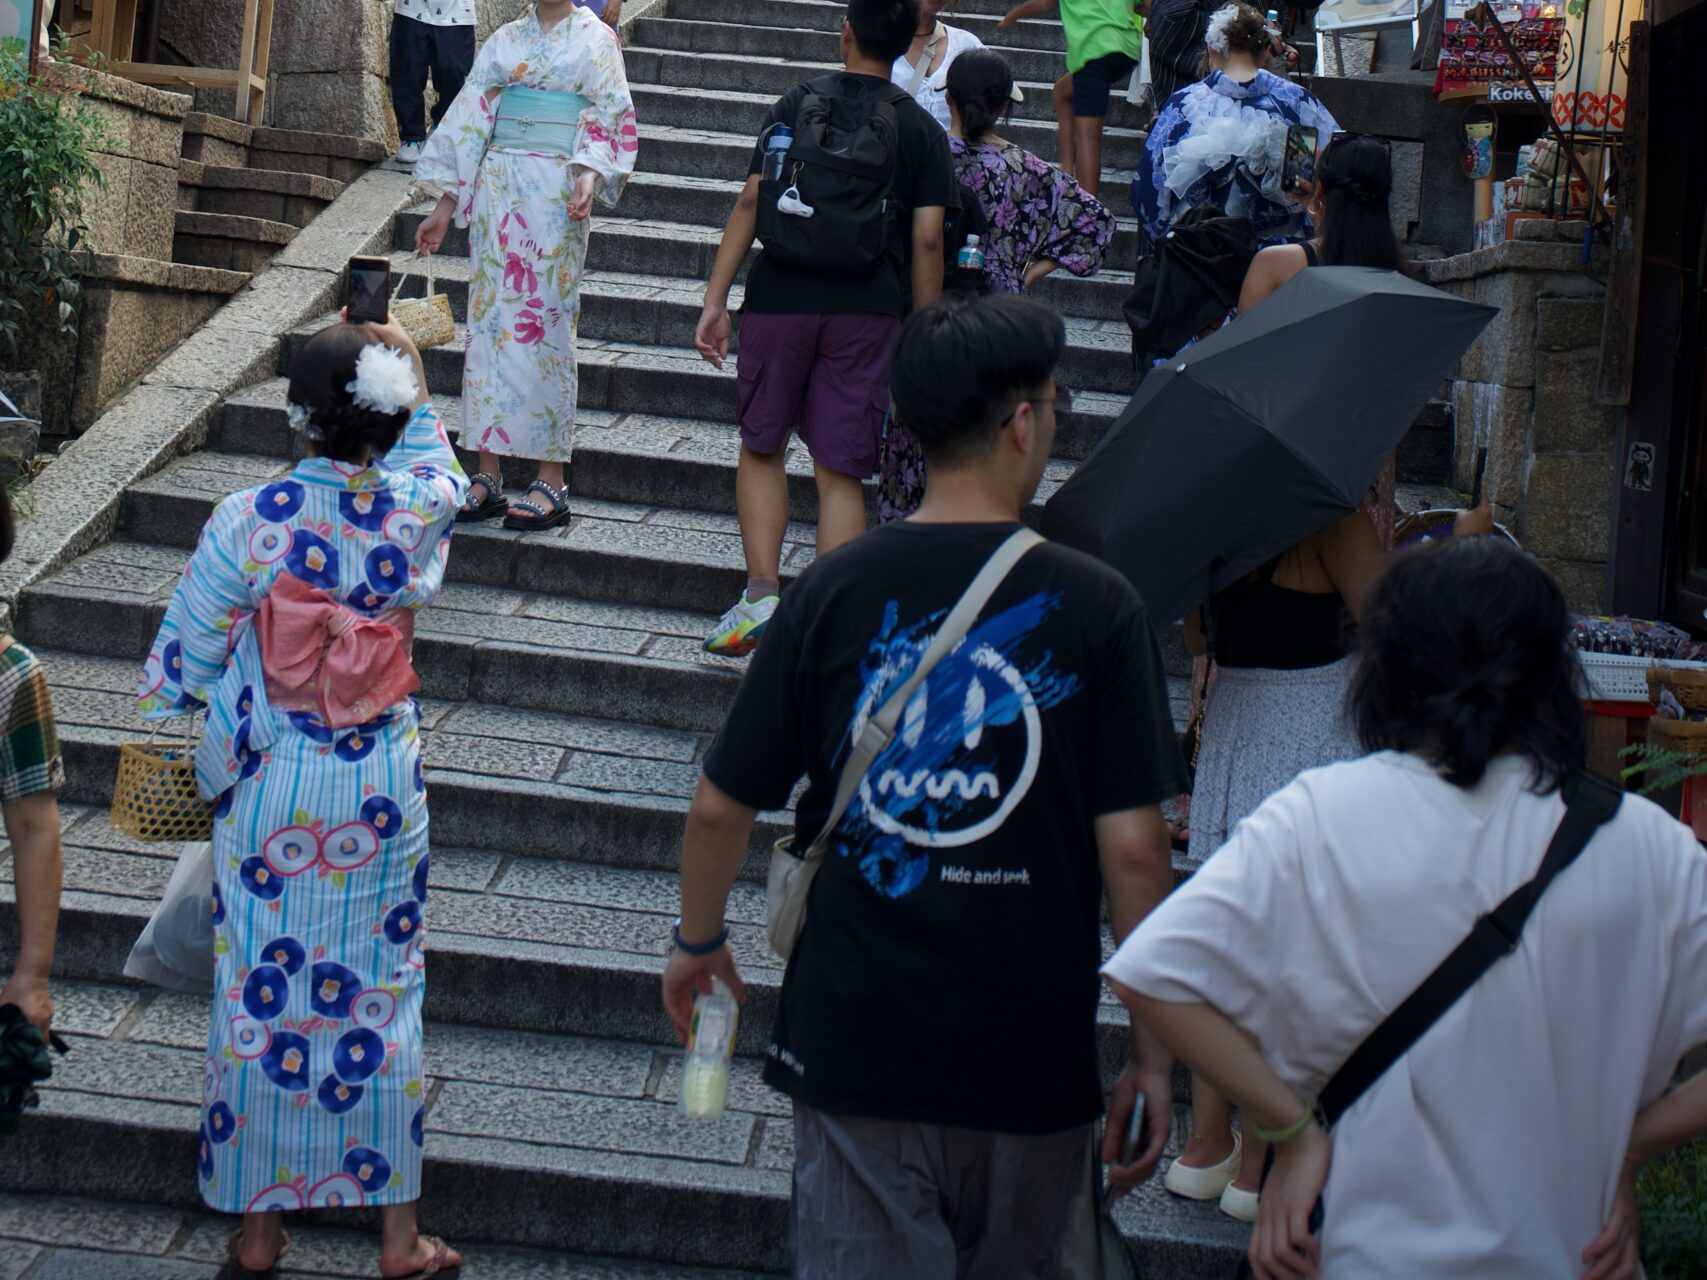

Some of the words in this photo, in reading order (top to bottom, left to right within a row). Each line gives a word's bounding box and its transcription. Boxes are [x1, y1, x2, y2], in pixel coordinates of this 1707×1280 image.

[941, 864, 973, 884] Hide
[973, 866, 1002, 885] and
[1002, 867, 1031, 885] seek
